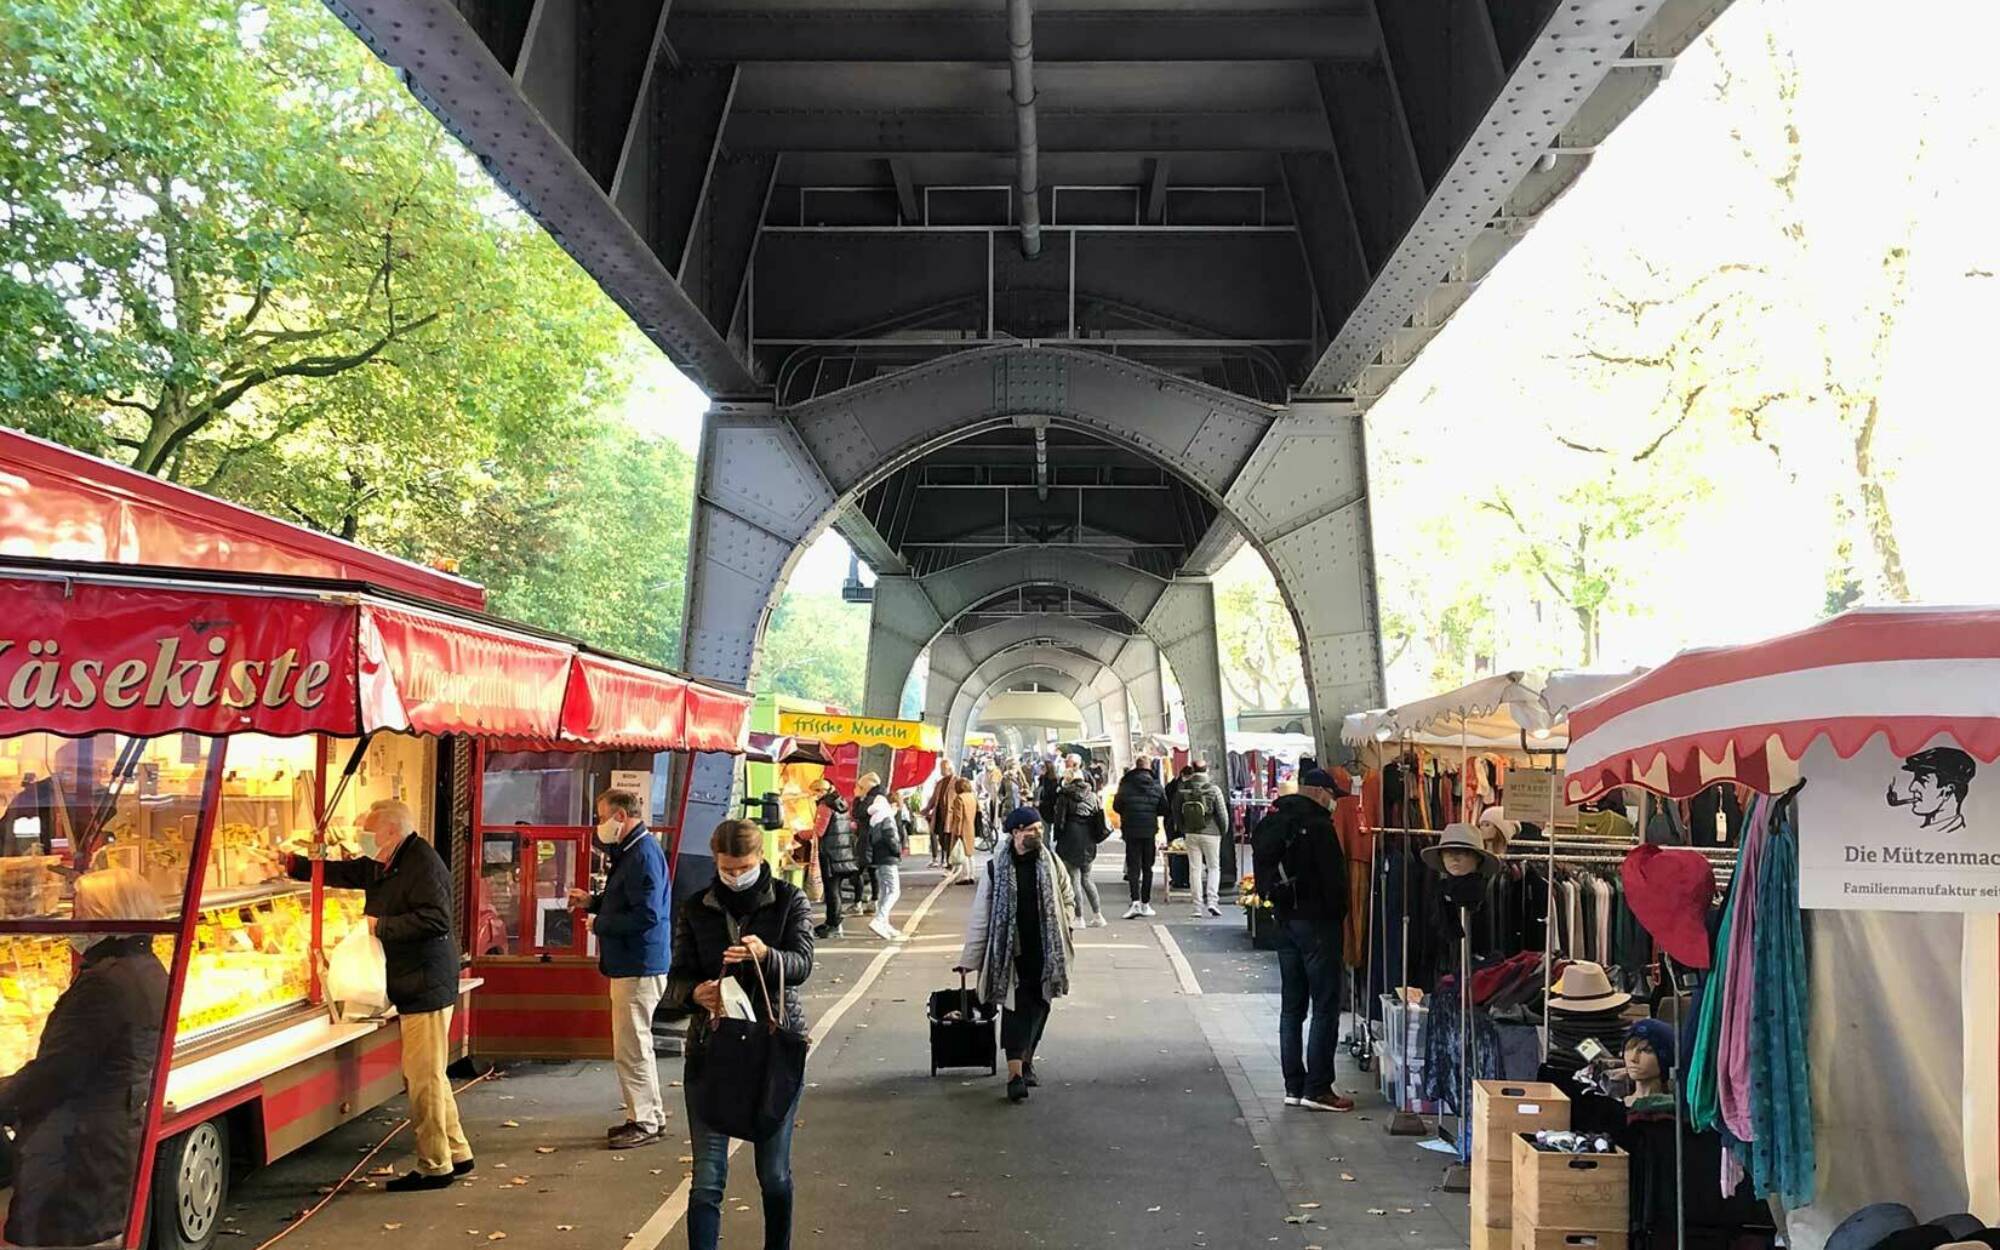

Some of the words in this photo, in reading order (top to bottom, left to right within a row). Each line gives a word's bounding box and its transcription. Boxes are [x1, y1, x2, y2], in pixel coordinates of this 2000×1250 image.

[793, 718, 843, 734] frische
[851, 721, 908, 739] Nudeln
[1844, 845, 1877, 863] Die
[1843, 882, 1977, 897] Familienmanufaktur
